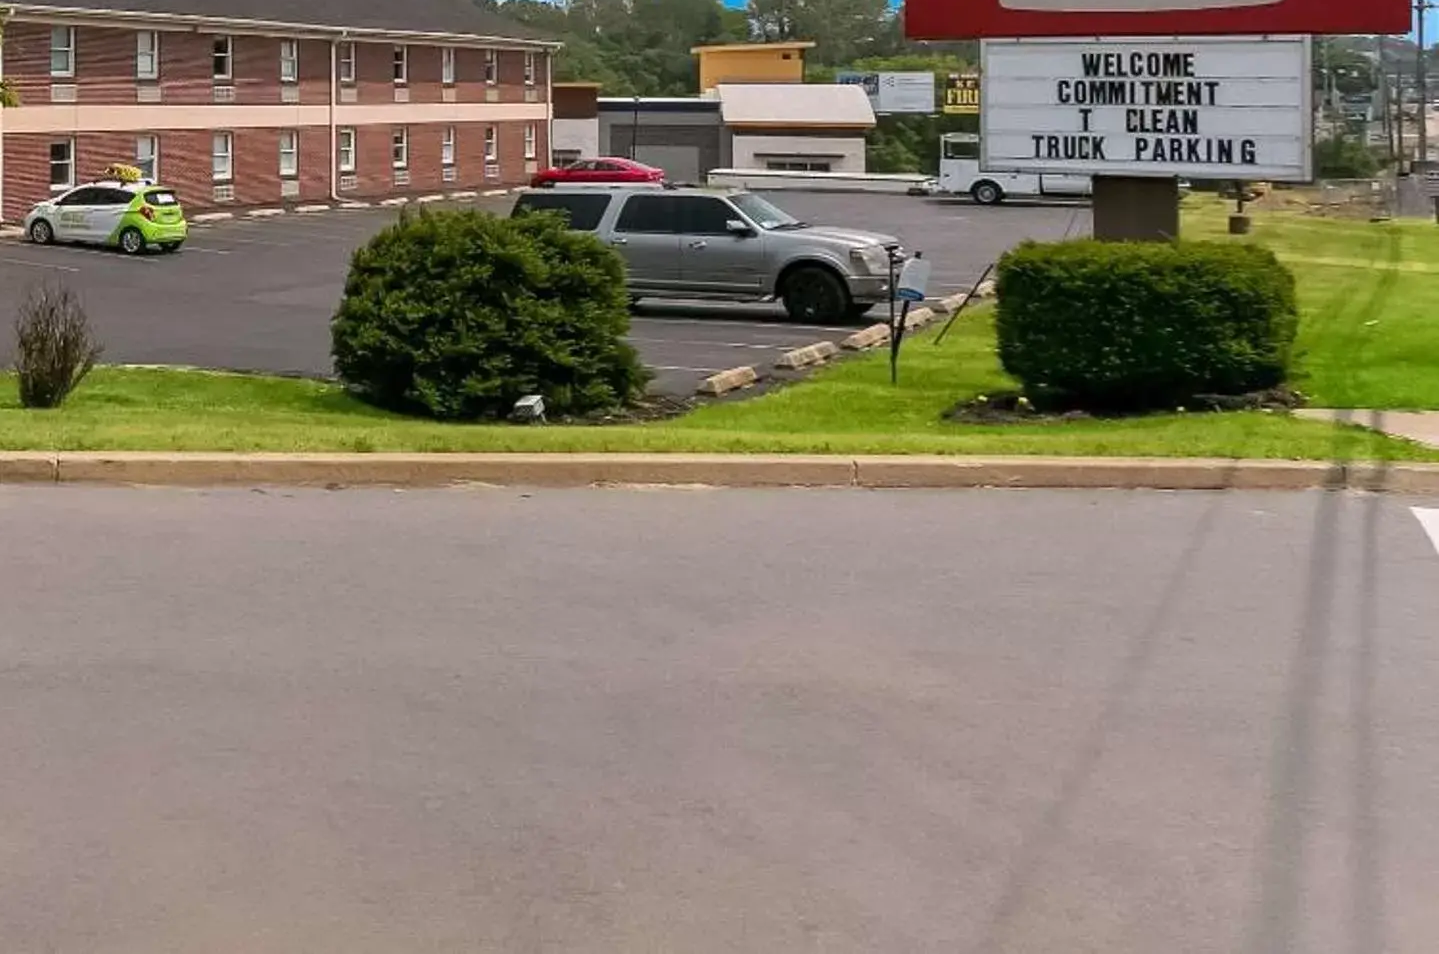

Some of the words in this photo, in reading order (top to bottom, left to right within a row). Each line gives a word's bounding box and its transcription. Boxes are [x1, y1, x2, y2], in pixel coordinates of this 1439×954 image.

[1082, 53, 1195, 77] WELCOME
[1057, 80, 1220, 106] COMMITMENT
[1078, 108, 1092, 131] T
[1125, 109, 1199, 134] CLEAN
[1032, 135, 1106, 160] TRUCK
[1135, 137, 1258, 164] PARKING
